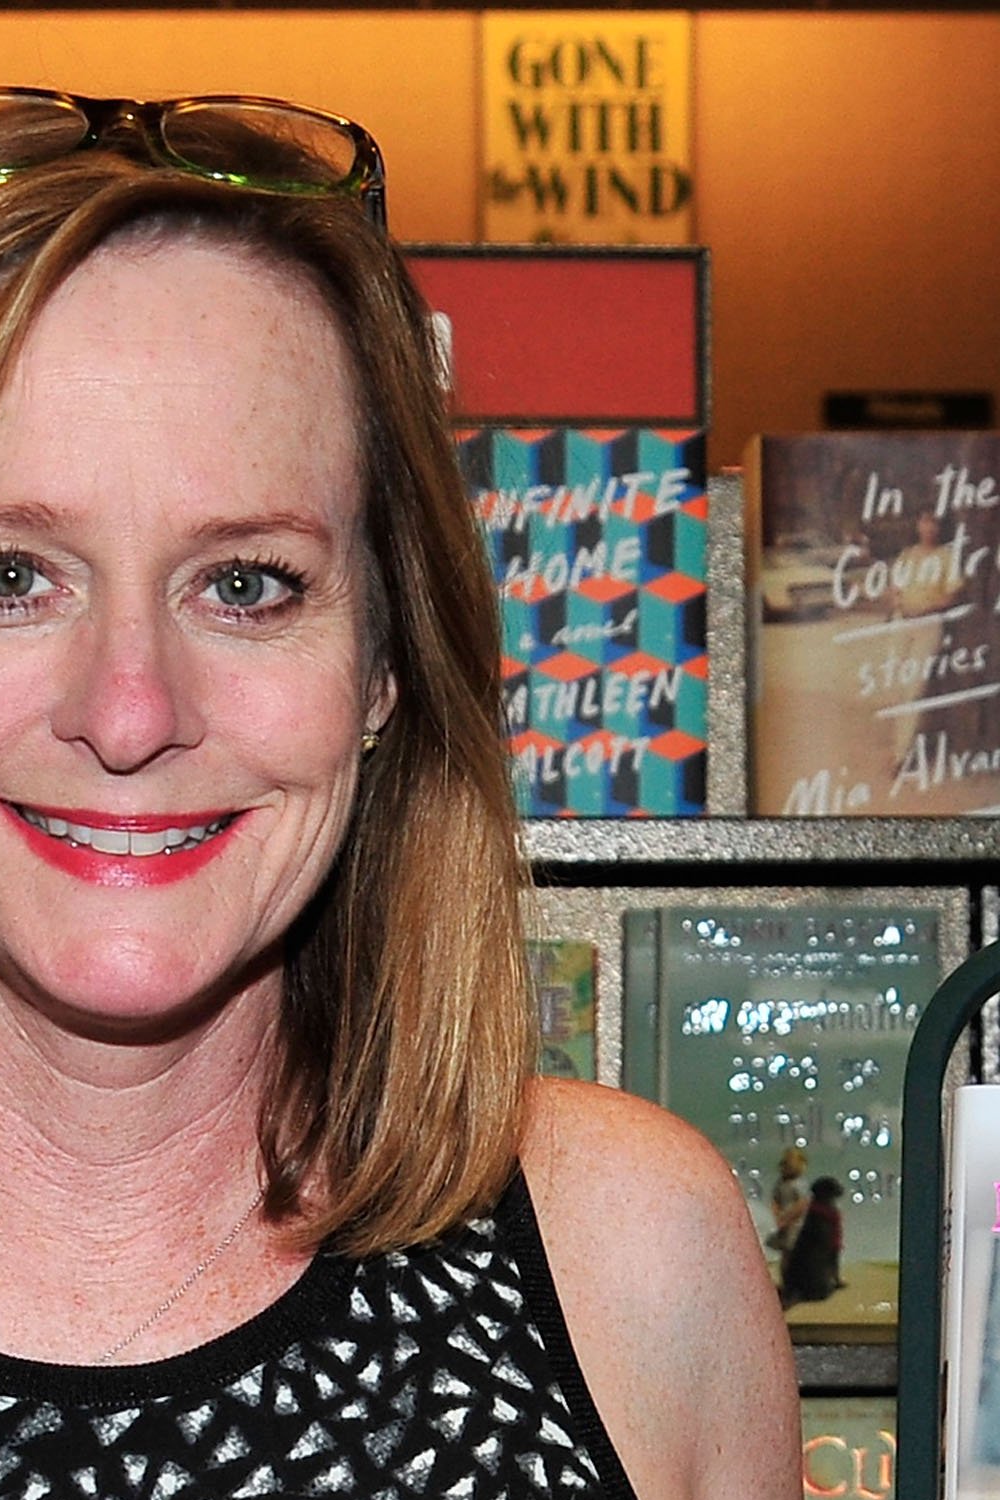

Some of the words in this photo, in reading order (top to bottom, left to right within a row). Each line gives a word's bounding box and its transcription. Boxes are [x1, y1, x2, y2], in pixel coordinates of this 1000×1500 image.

[506, 34, 665, 89] GONE
[507, 98, 662, 154] WITH
[525, 163, 692, 218] WIND
[862, 471, 904, 522] In
[935, 463, 1000, 518] the
[500, 536, 641, 600] HOME
[832, 521, 1000, 613] Countr
[857, 633, 990, 697] stories
[518, 735, 651, 785] ALCOTT
